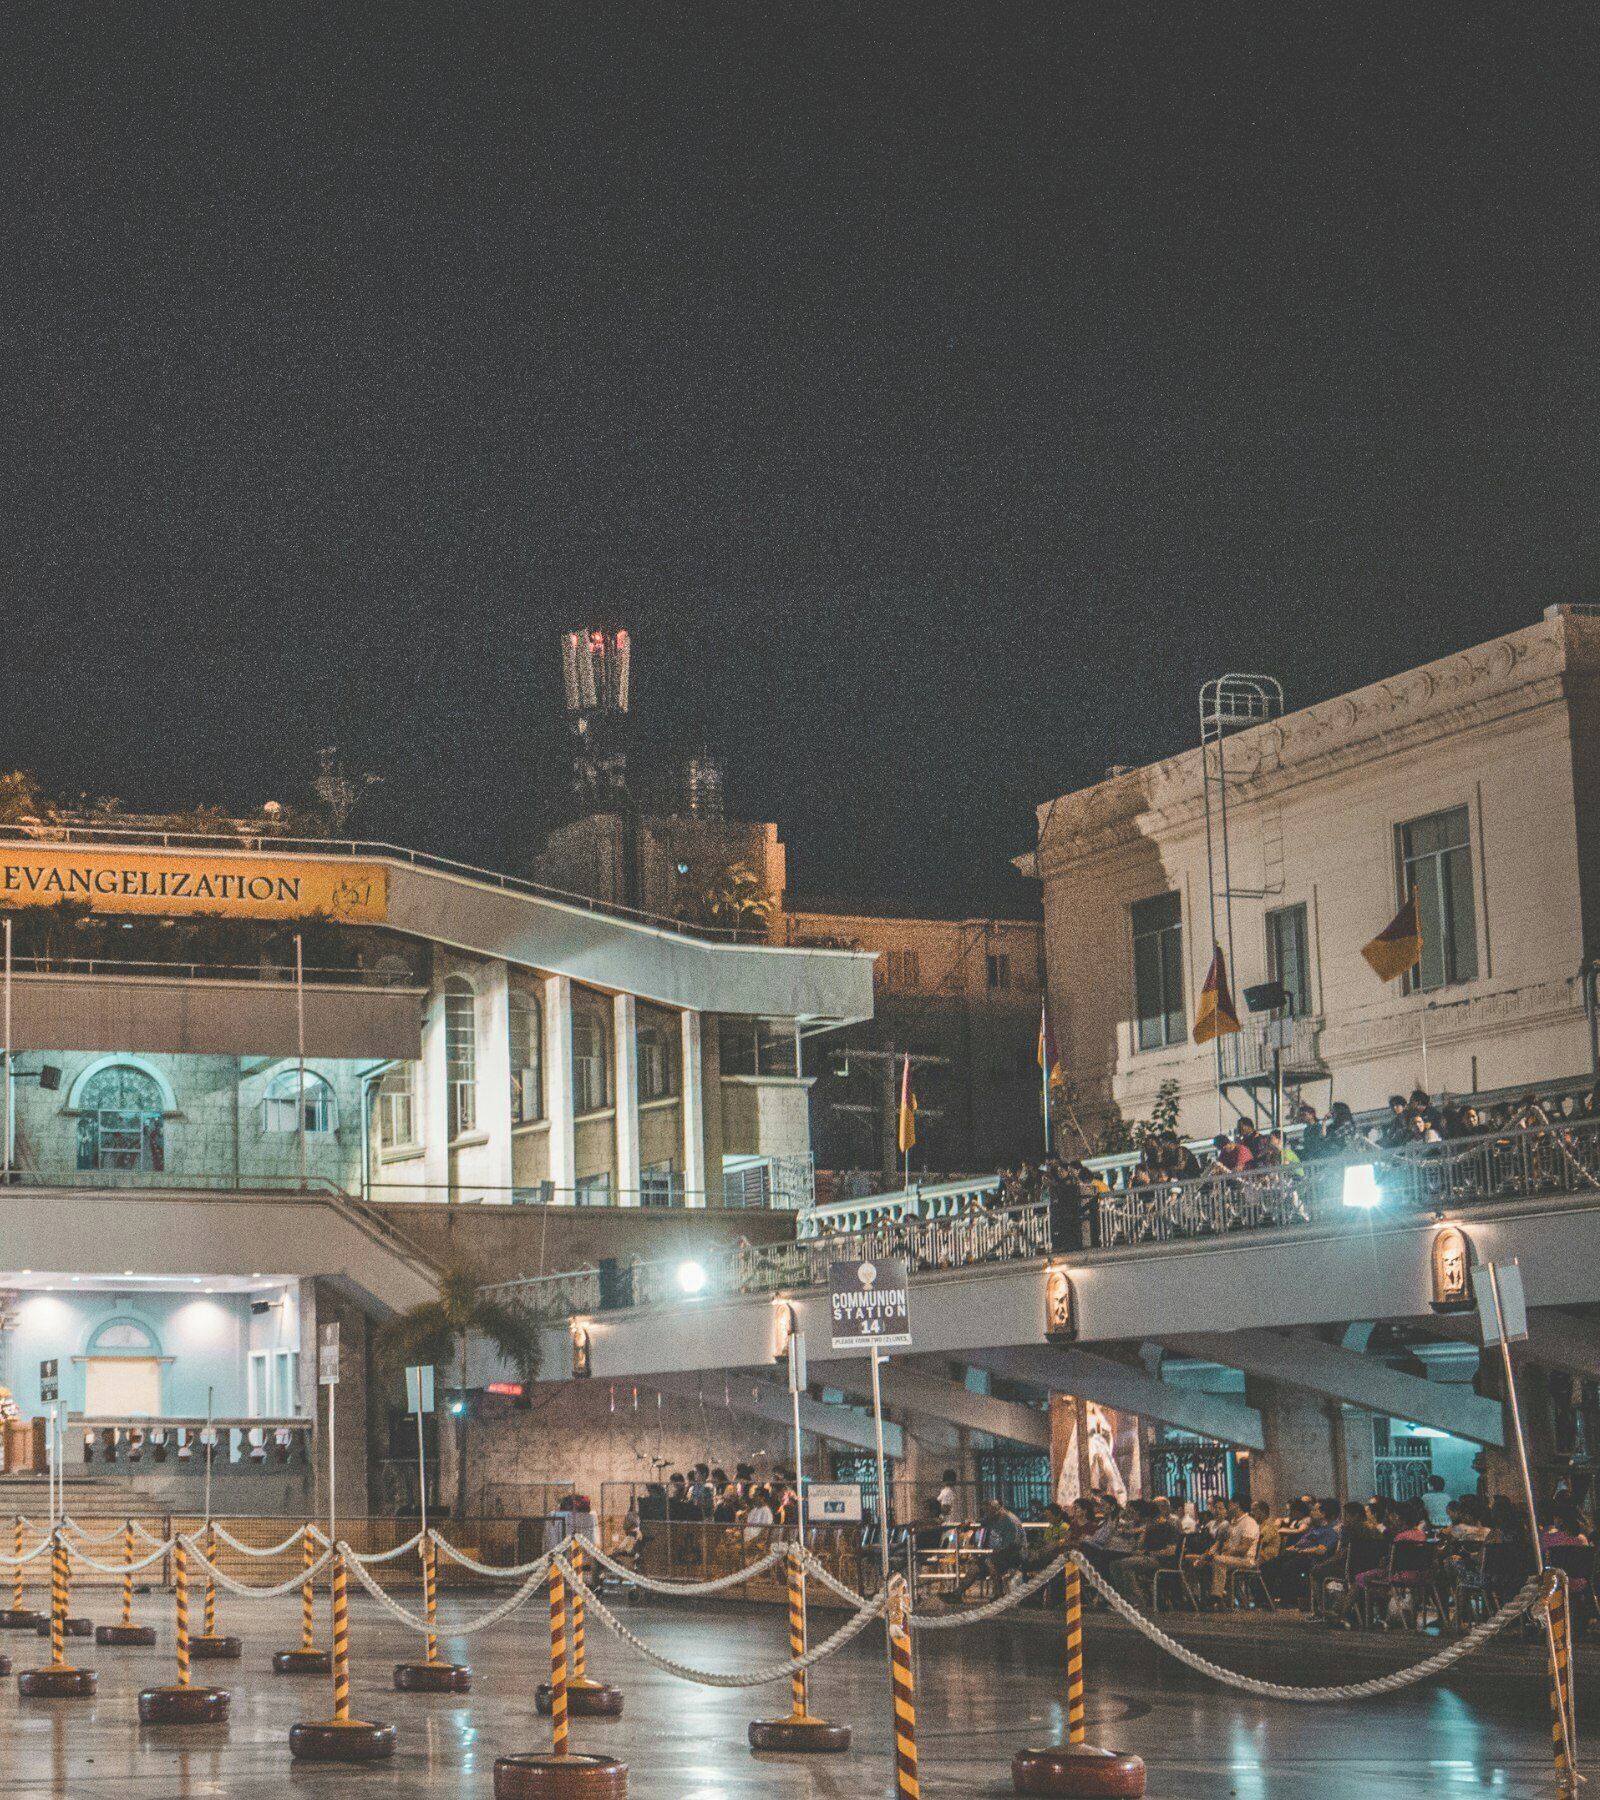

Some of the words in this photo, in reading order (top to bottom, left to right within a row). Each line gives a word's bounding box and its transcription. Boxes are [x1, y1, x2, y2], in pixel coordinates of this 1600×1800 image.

[3, 866, 301, 901] EVANGELIZATION
[832, 1289, 906, 1308] COMMUNION
[833, 1305, 906, 1320] STATION
[861, 1320, 880, 1334] 14
